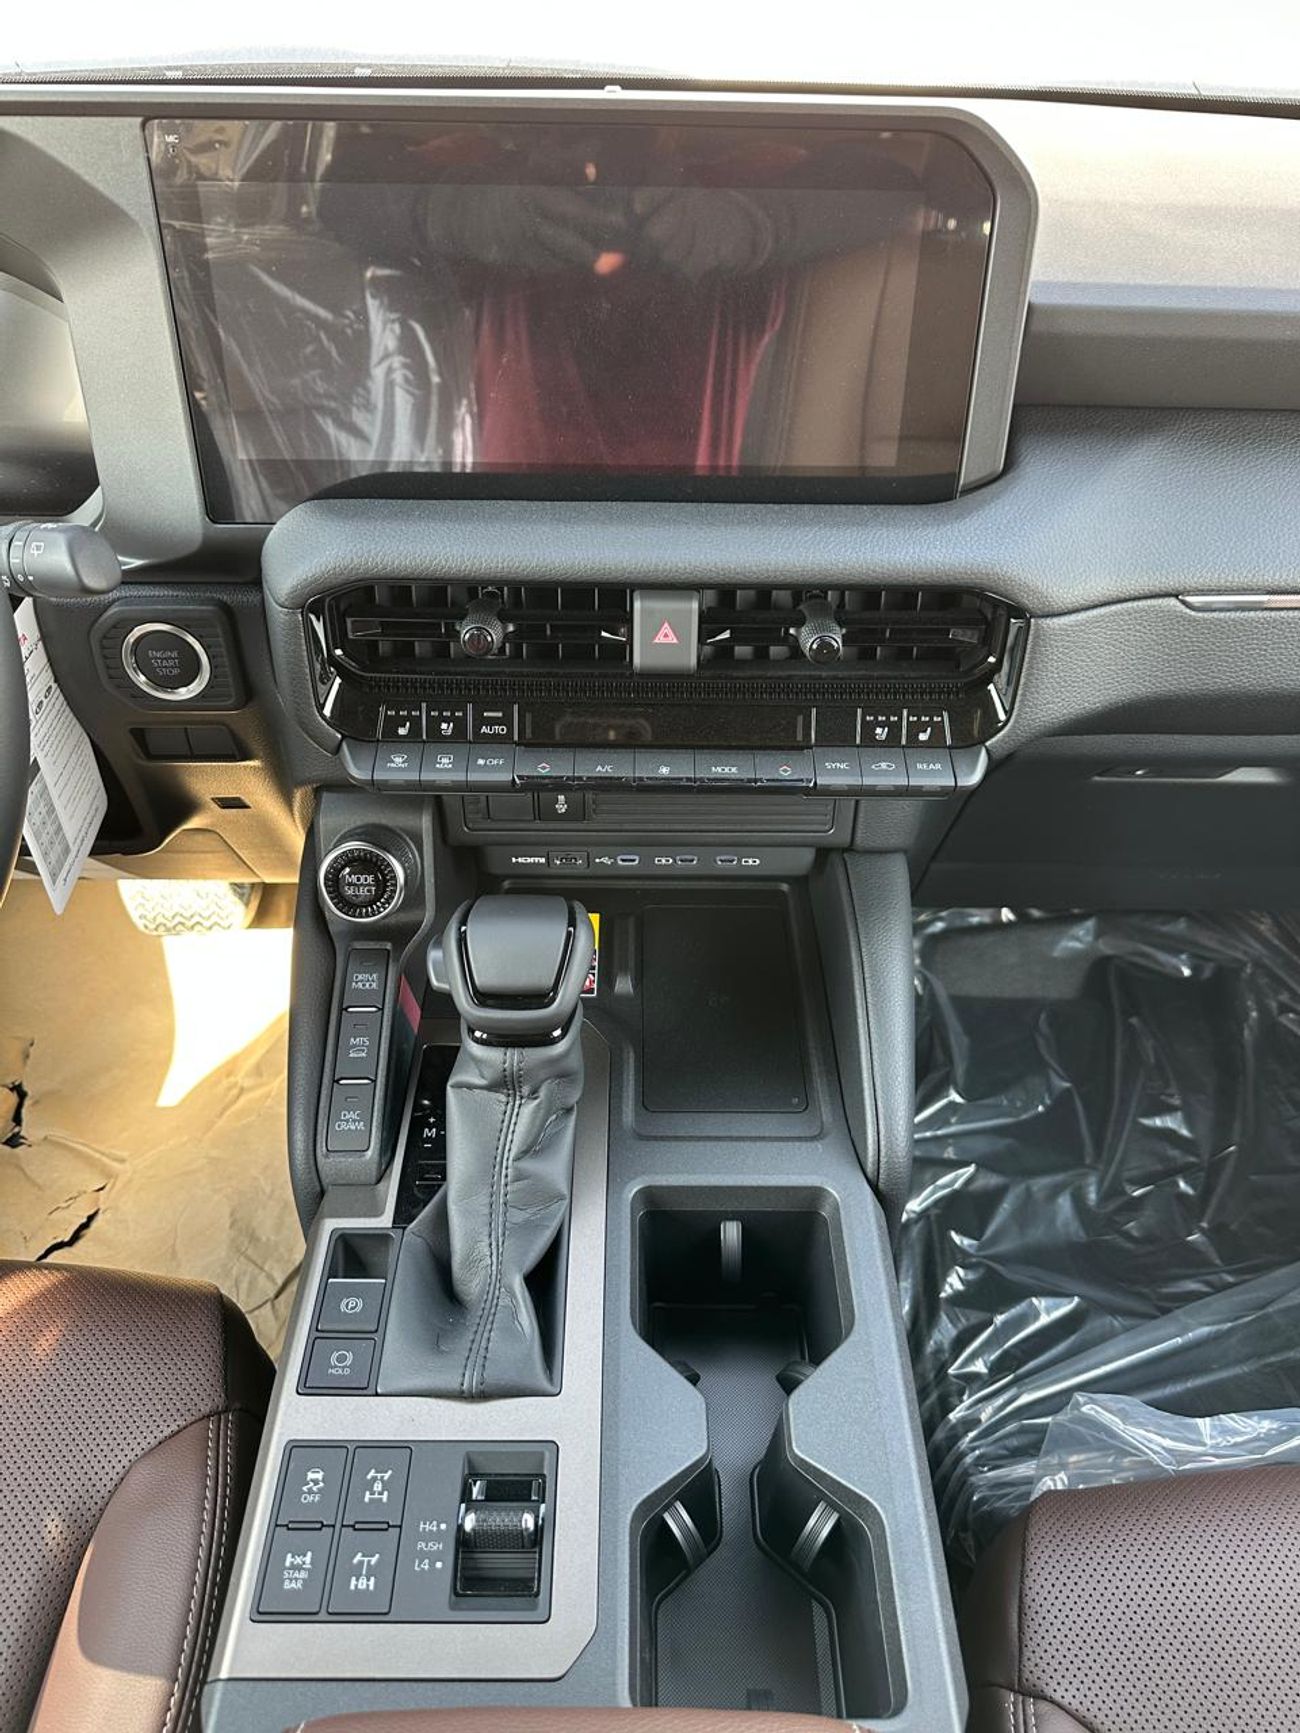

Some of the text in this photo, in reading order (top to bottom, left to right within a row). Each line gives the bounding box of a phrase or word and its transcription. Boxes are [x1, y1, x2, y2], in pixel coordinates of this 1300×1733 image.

[148, 650, 179, 658] ENGINE
[480, 726, 506, 734] AUTO
[345, 874, 375, 884] MODE
[344, 886, 376, 894] SELECT
[353, 974, 379, 982] DRIVE
[350, 1038, 370, 1046] MTS
[340, 1110, 361, 1120] DAC
[335, 1122, 365, 1130] CRAWL
[423, 1128, 436, 1138] M
[301, 1494, 322, 1503] OFF
[419, 1521, 438, 1532] H4
[416, 1542, 443, 1550] PUSH
[414, 1559, 430, 1571] L4
[283, 1570, 308, 1579] STABI
[283, 1580, 302, 1590] BAR
